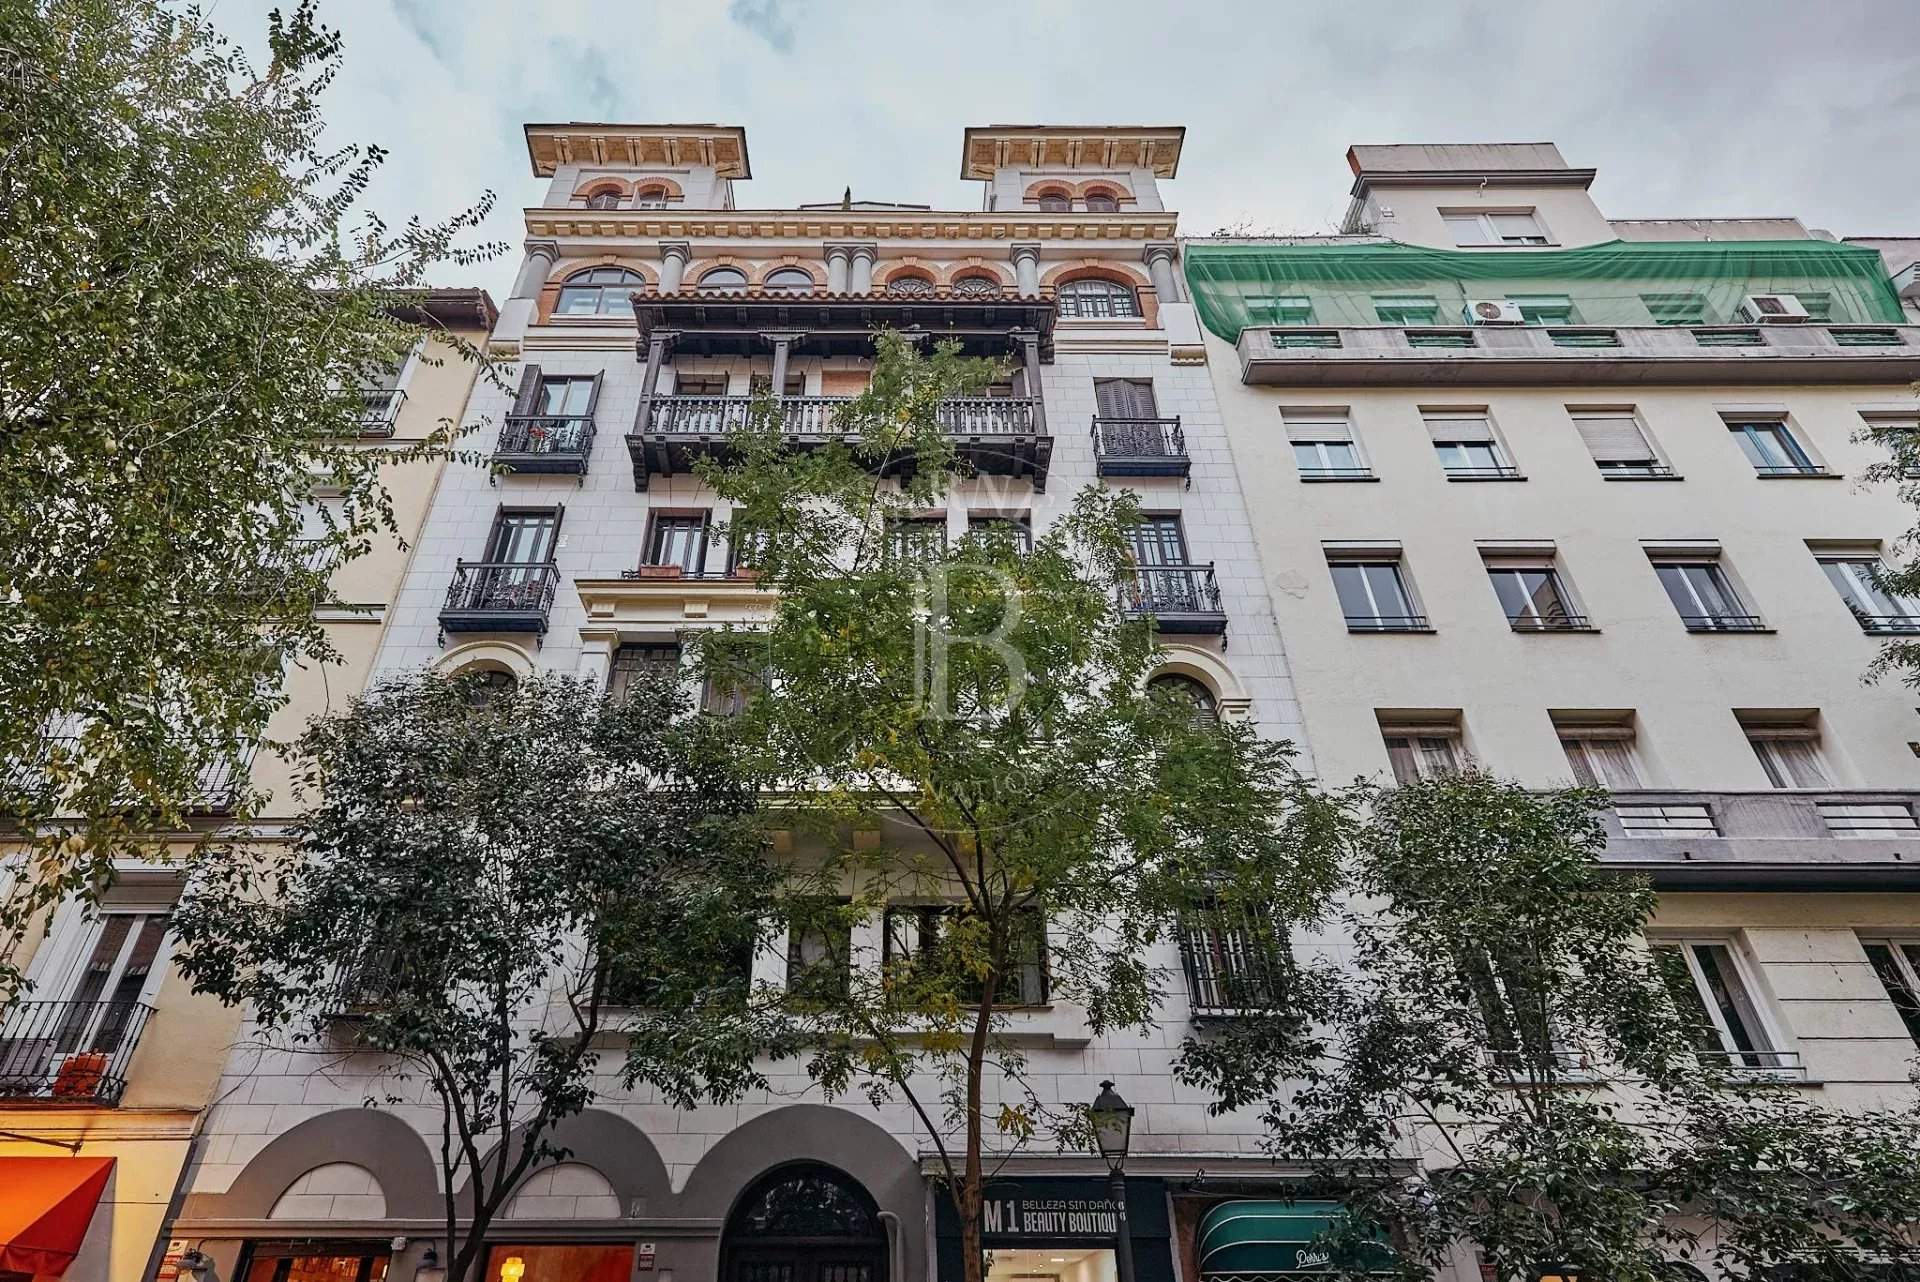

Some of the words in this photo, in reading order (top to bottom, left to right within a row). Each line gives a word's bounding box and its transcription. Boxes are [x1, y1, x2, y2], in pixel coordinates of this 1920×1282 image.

[1022, 1200, 1066, 1210] BELLEZA
[1068, 1200, 1087, 1210] SIN
[984, 1200, 1020, 1232] M1
[1023, 1212, 1066, 1232] BEAUTY
[1069, 1212, 1117, 1232] BOUTIQU
